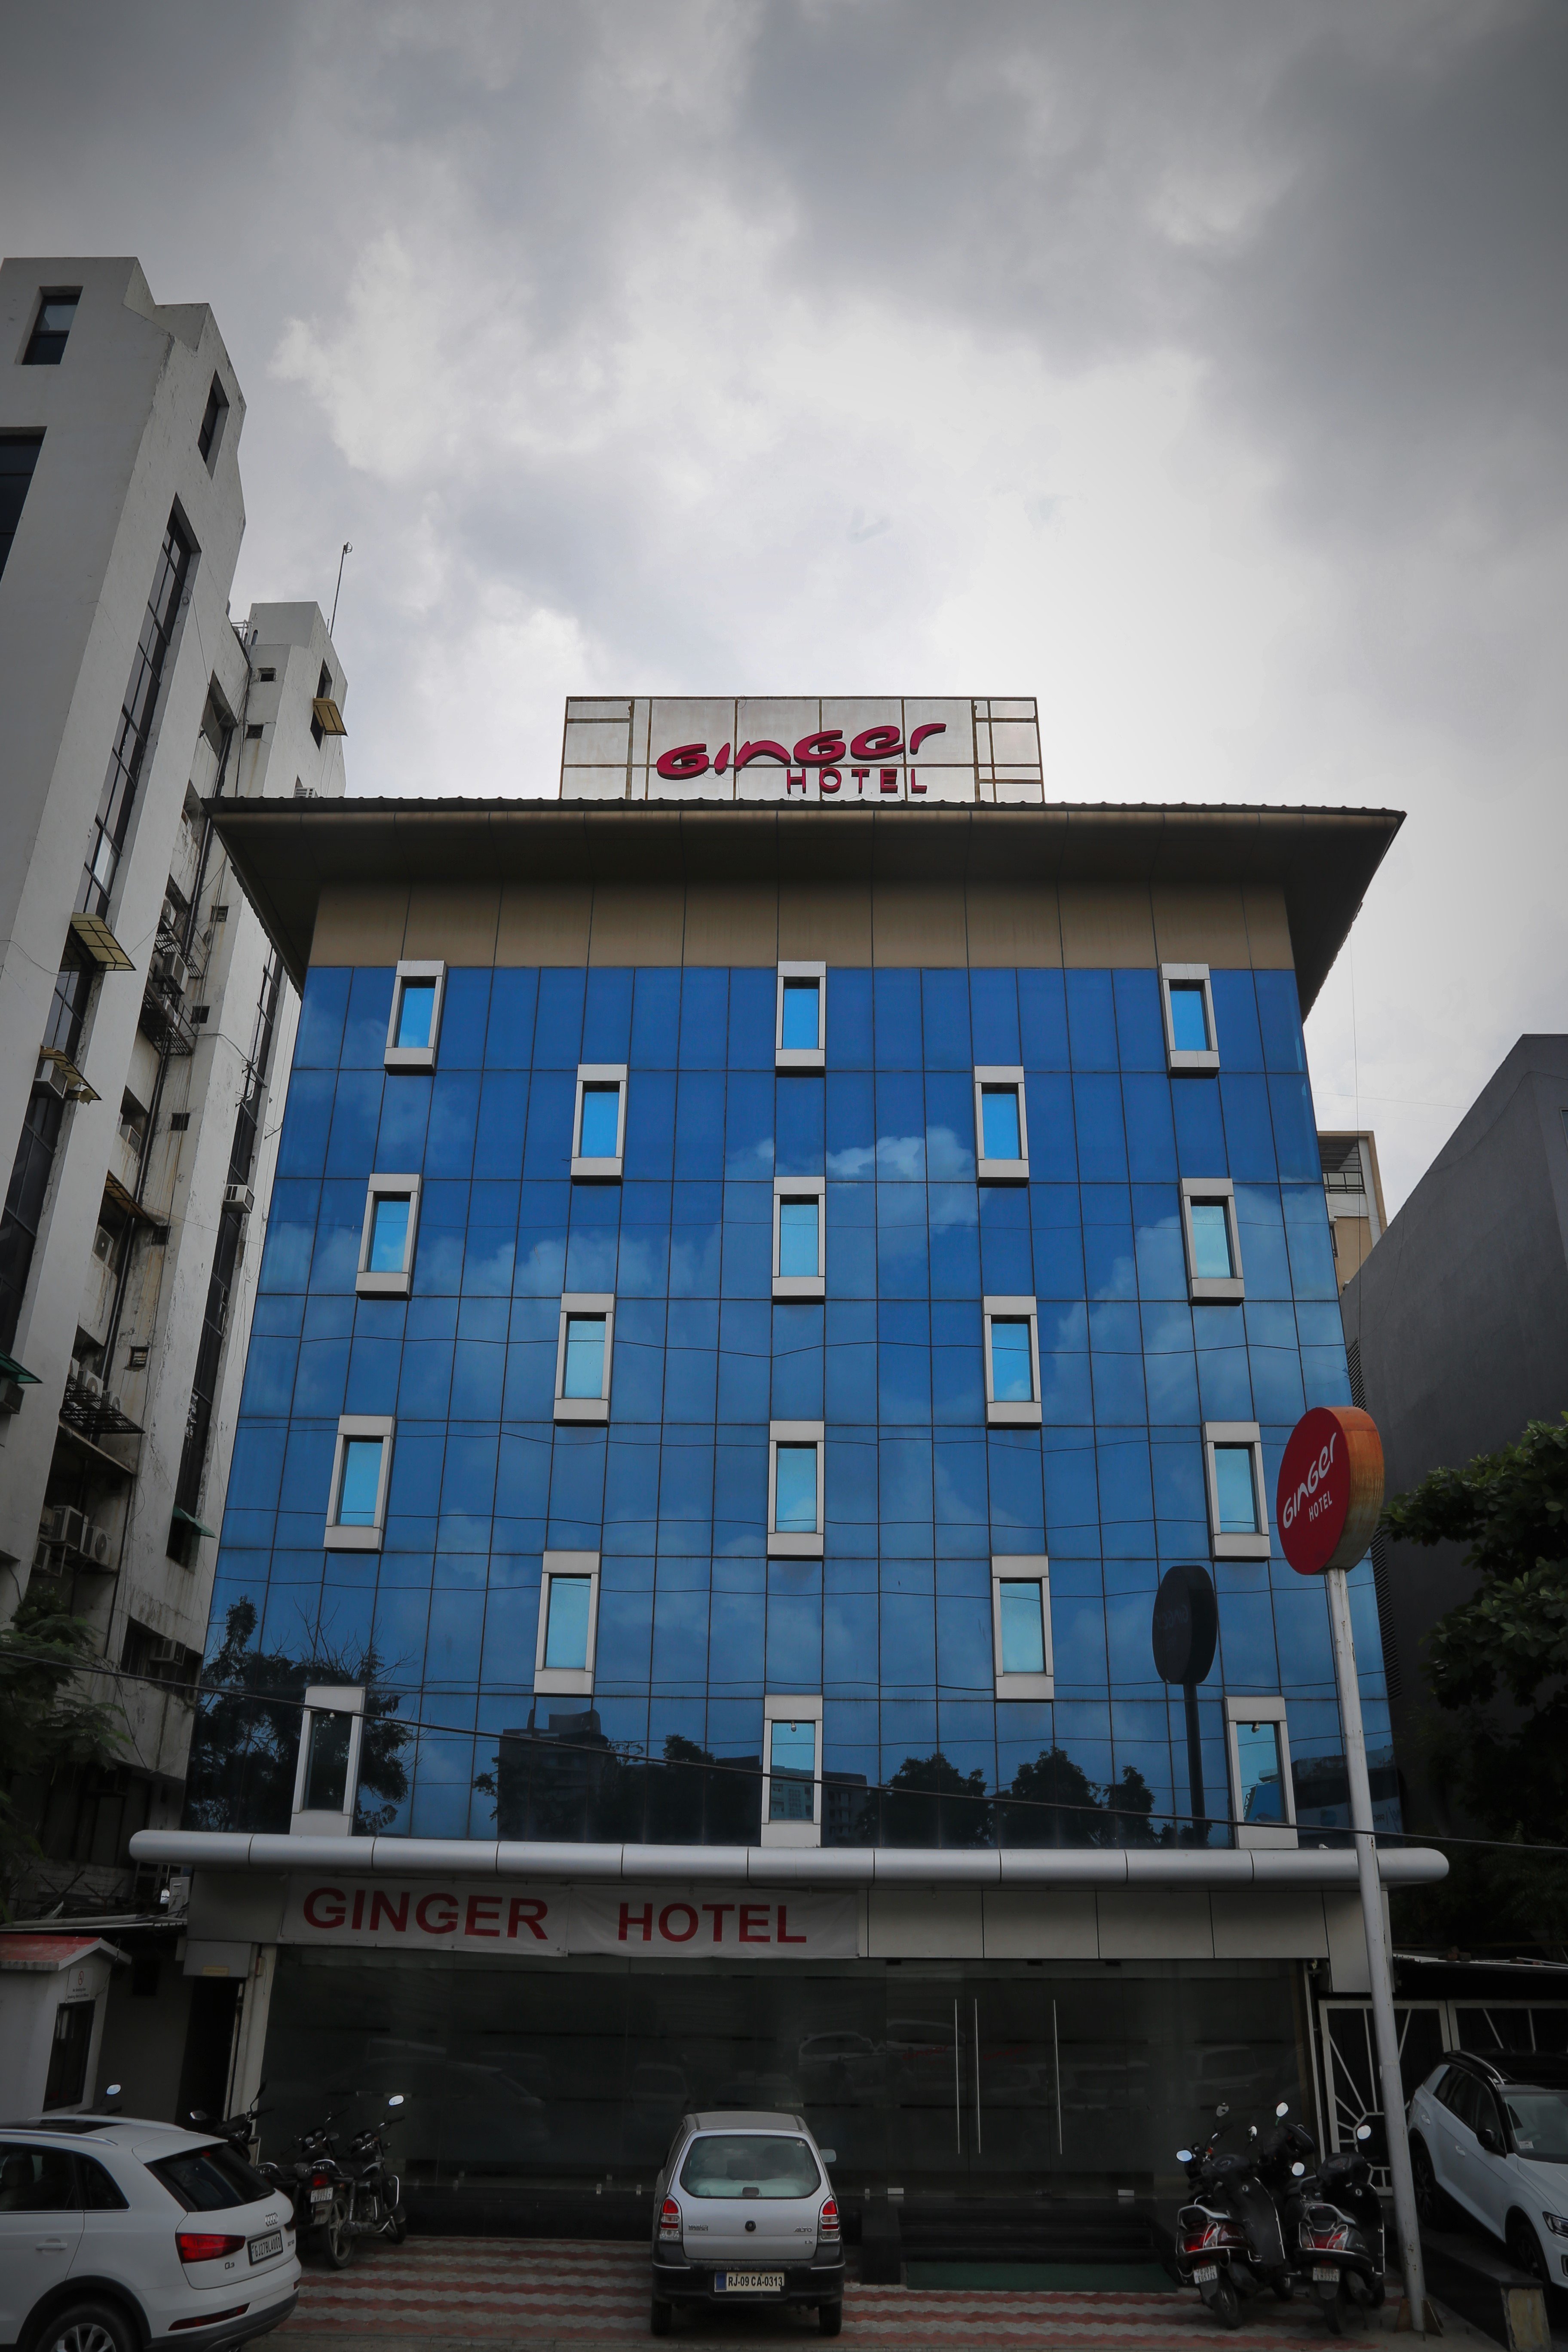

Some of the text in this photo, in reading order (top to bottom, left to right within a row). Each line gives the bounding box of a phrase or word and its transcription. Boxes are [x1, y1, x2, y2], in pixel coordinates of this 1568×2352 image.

[786, 768, 928, 794] HOTEL
[1309, 1490, 1332, 1522] HOTEL
[303, 1887, 807, 1944] GINGER HOTEL
[728, 2276, 749, 2286] RJ-09
